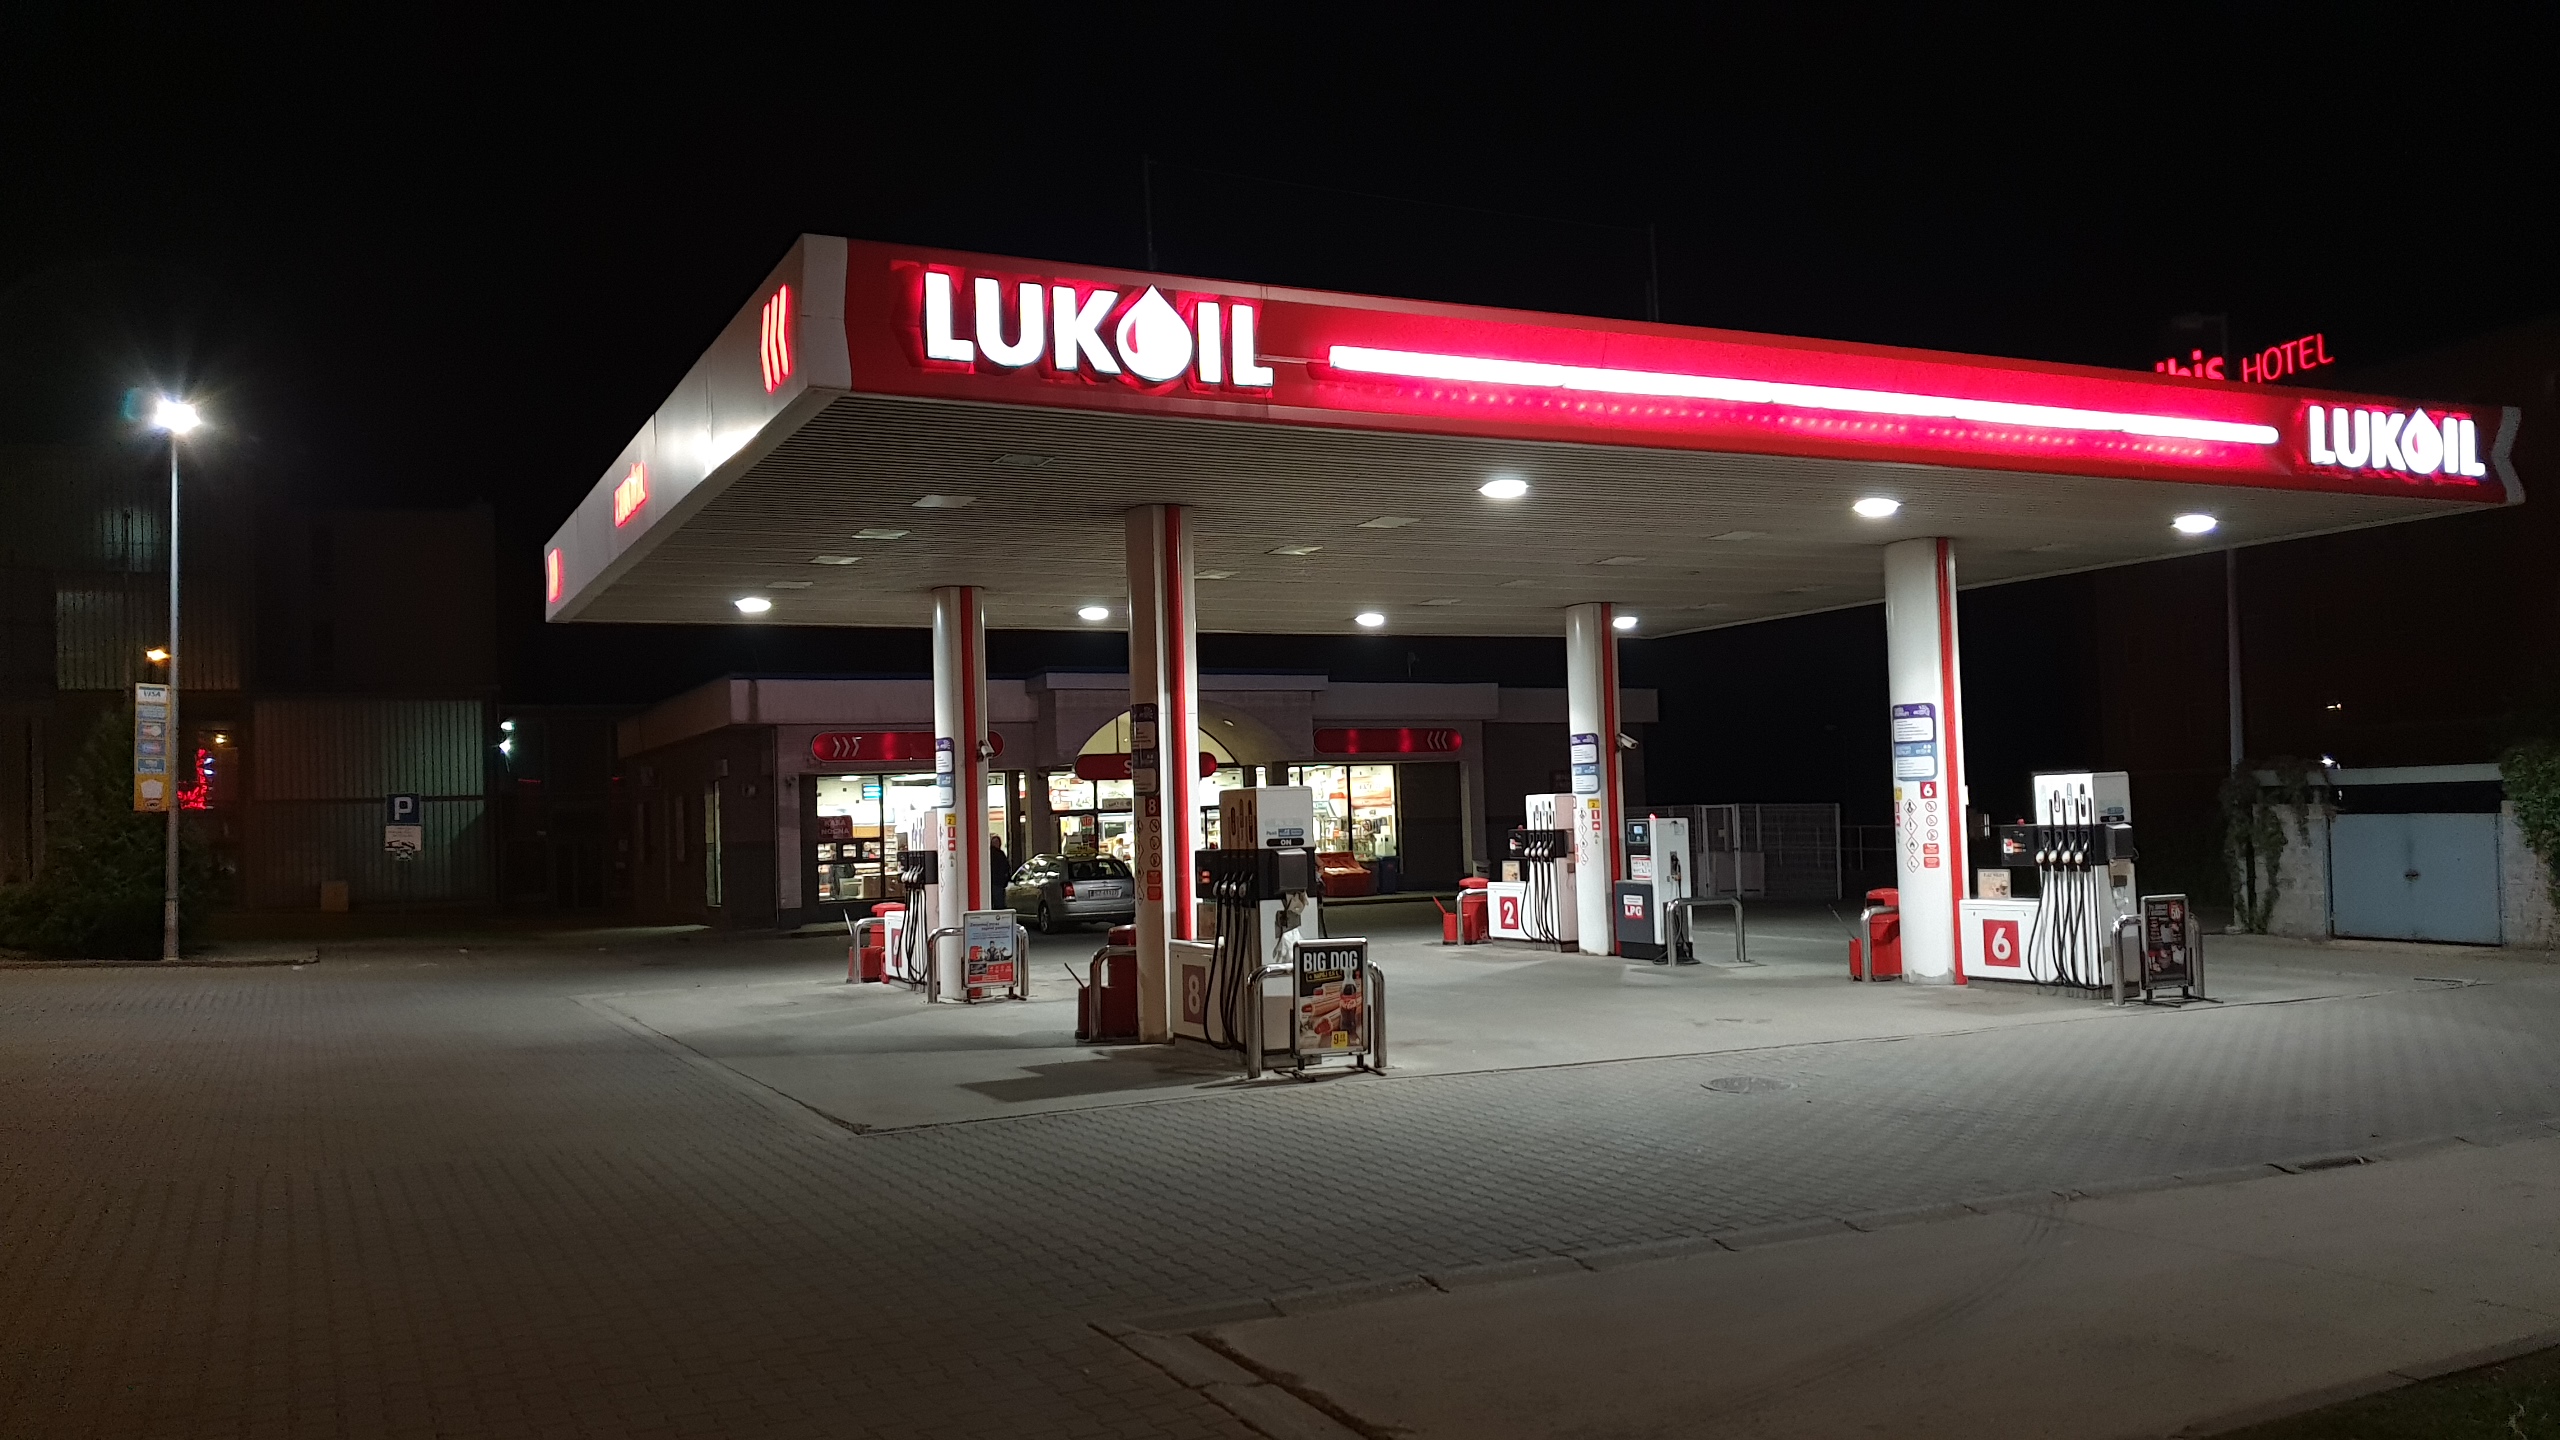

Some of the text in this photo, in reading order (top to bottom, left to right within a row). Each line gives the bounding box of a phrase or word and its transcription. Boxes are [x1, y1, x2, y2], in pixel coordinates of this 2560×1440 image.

[925, 271, 1274, 387] LUKOIL
[2156, 333, 2334, 383] bis HOTEL
[2308, 405, 2487, 477] LUKOIL
[1923, 783, 1934, 797] 6
[394, 796, 412, 821] P
[1148, 799, 1157, 813] 8
[1503, 901, 1515, 925] 2
[1624, 905, 1643, 916] LPG
[1992, 927, 2011, 960] 6
[1303, 950, 1358, 972] BIG DOG
[1188, 974, 1201, 1015] 8
